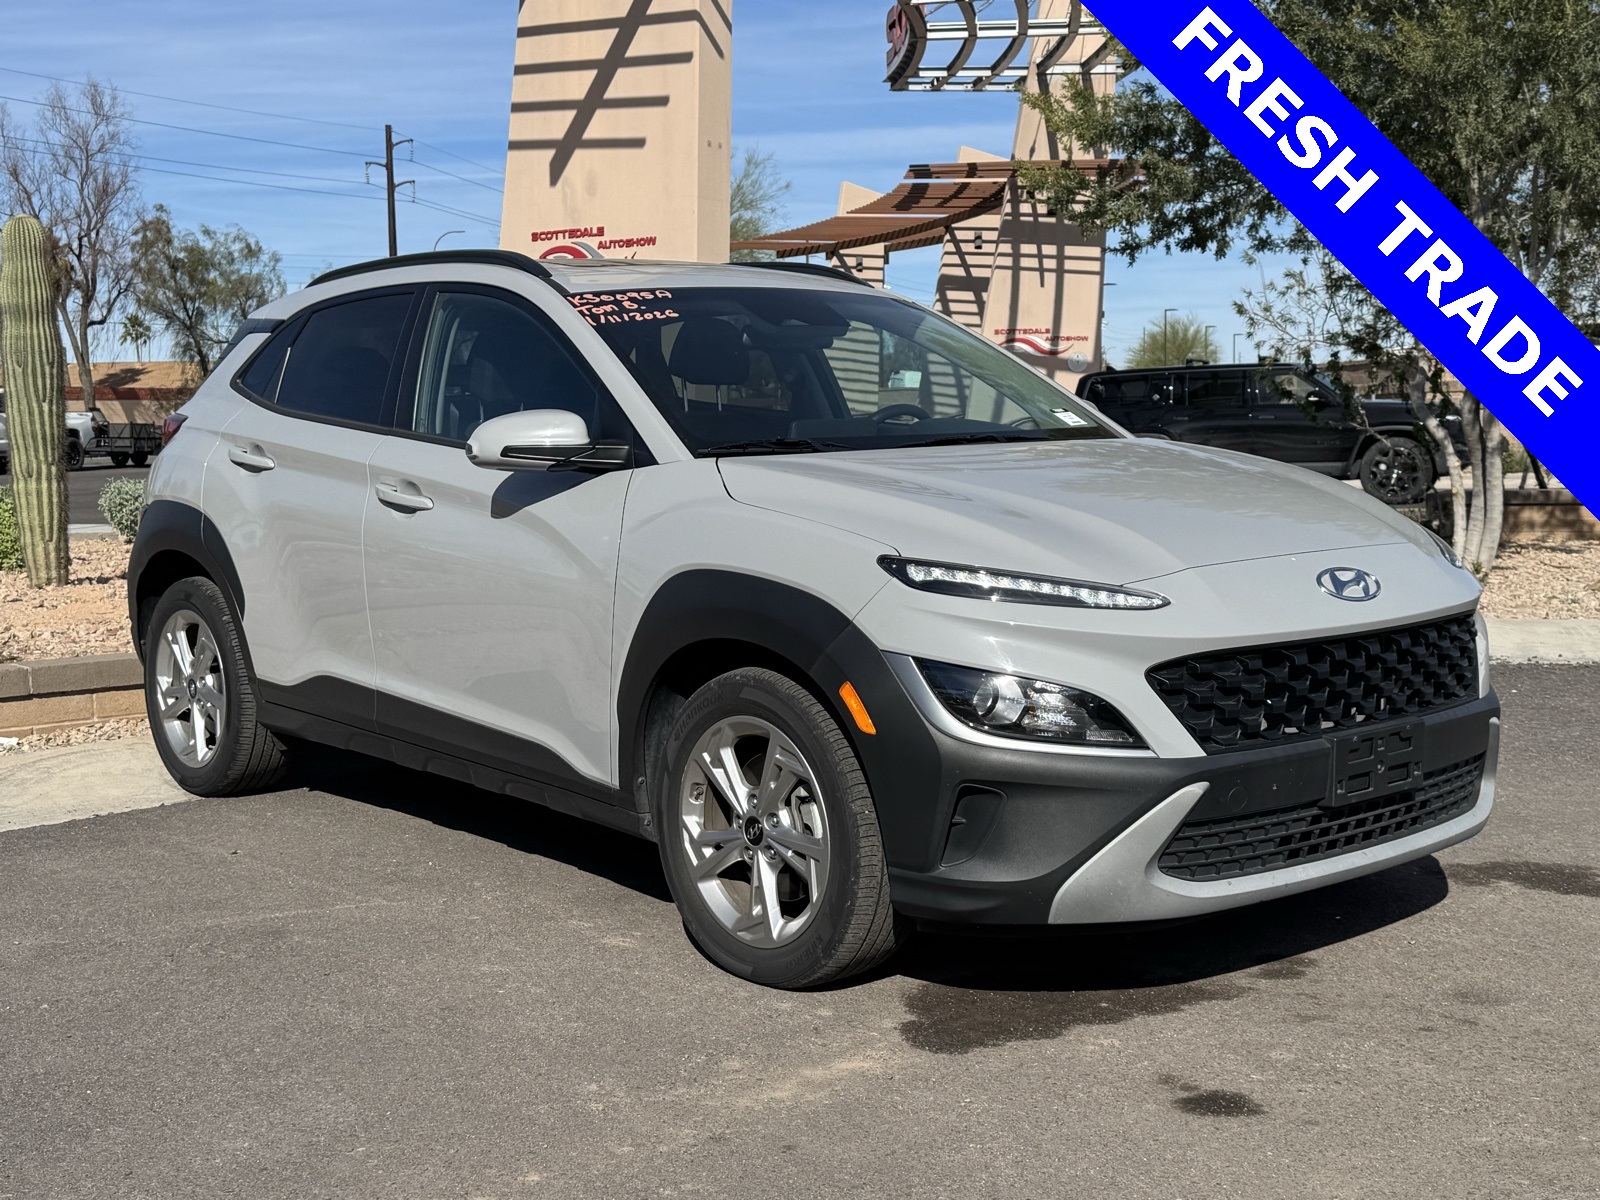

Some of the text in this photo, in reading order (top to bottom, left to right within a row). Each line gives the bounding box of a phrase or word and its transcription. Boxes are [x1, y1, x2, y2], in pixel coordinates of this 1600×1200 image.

[531, 226, 605, 242] SCOTTSDALE
[597, 236, 657, 250] AUTOSHOW
[994, 328, 1051, 336] SCOTTSDALE
